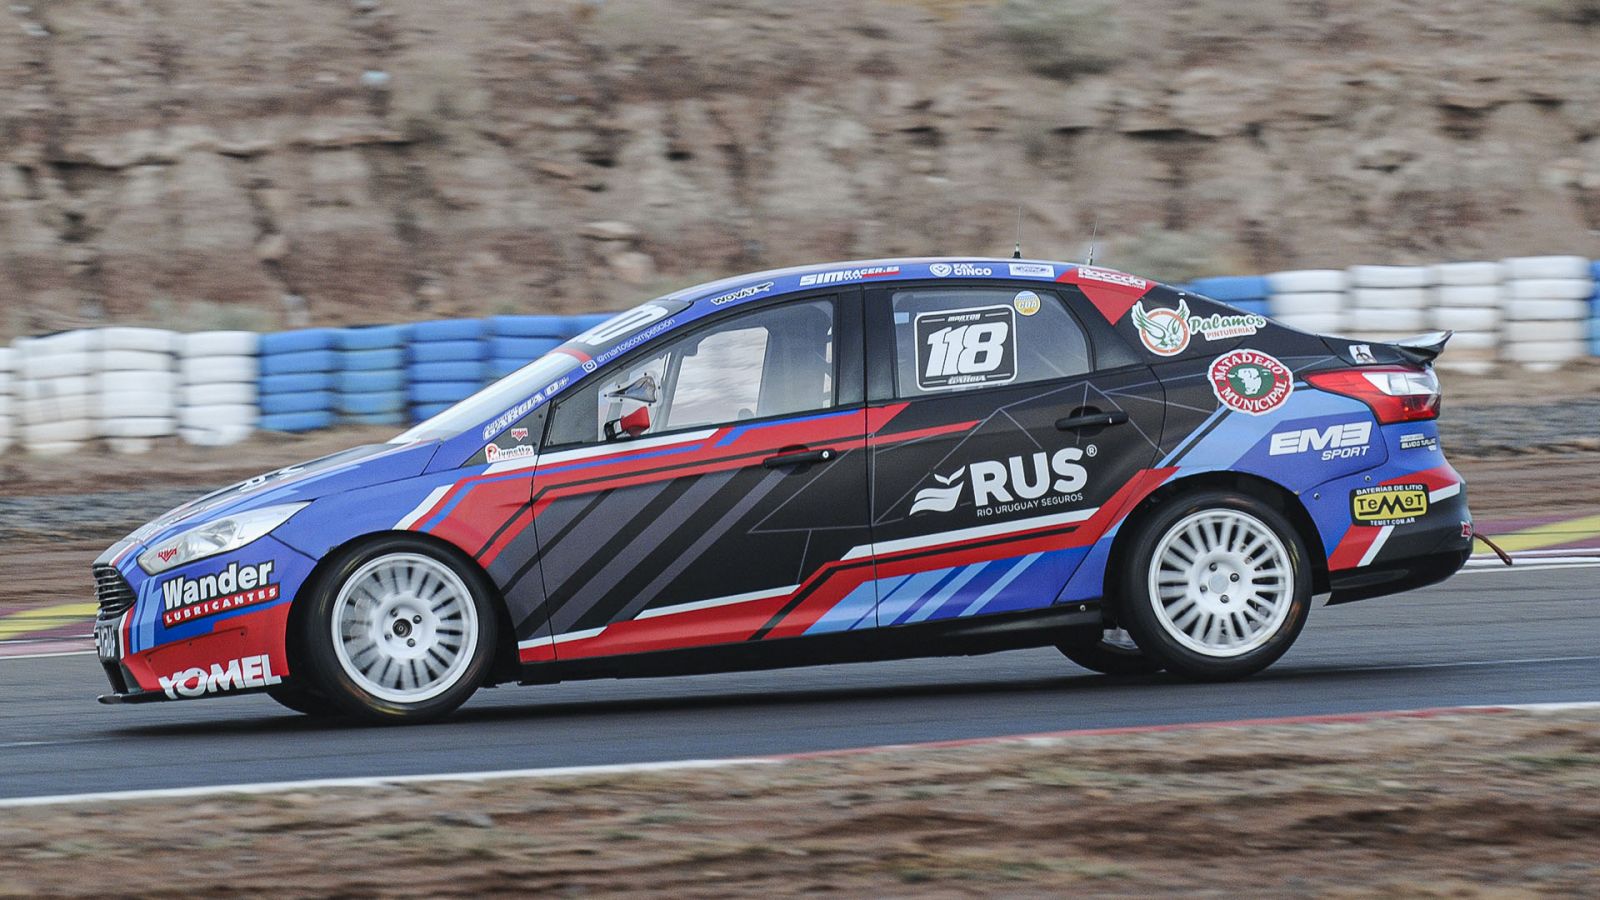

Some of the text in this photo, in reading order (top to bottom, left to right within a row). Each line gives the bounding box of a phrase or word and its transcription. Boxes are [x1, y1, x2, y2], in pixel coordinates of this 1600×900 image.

[954, 267, 992, 276] CINCO
[1190, 315, 1265, 334] Palamos
[925, 321, 1009, 378] 118
[1214, 353, 1284, 381] MATADERO
[1221, 381, 1288, 411] MUNICIPAL
[1321, 445, 1370, 461] SPORT
[969, 447, 1088, 507] RUS
[976, 492, 1084, 517] RIO URUGUAY SEGUROS
[1370, 517, 1416, 526] TEMET.COM.AR
[161, 561, 274, 611] Wander
[165, 587, 277, 624] LUBRICANTES
[158, 654, 282, 700] YOMEL
